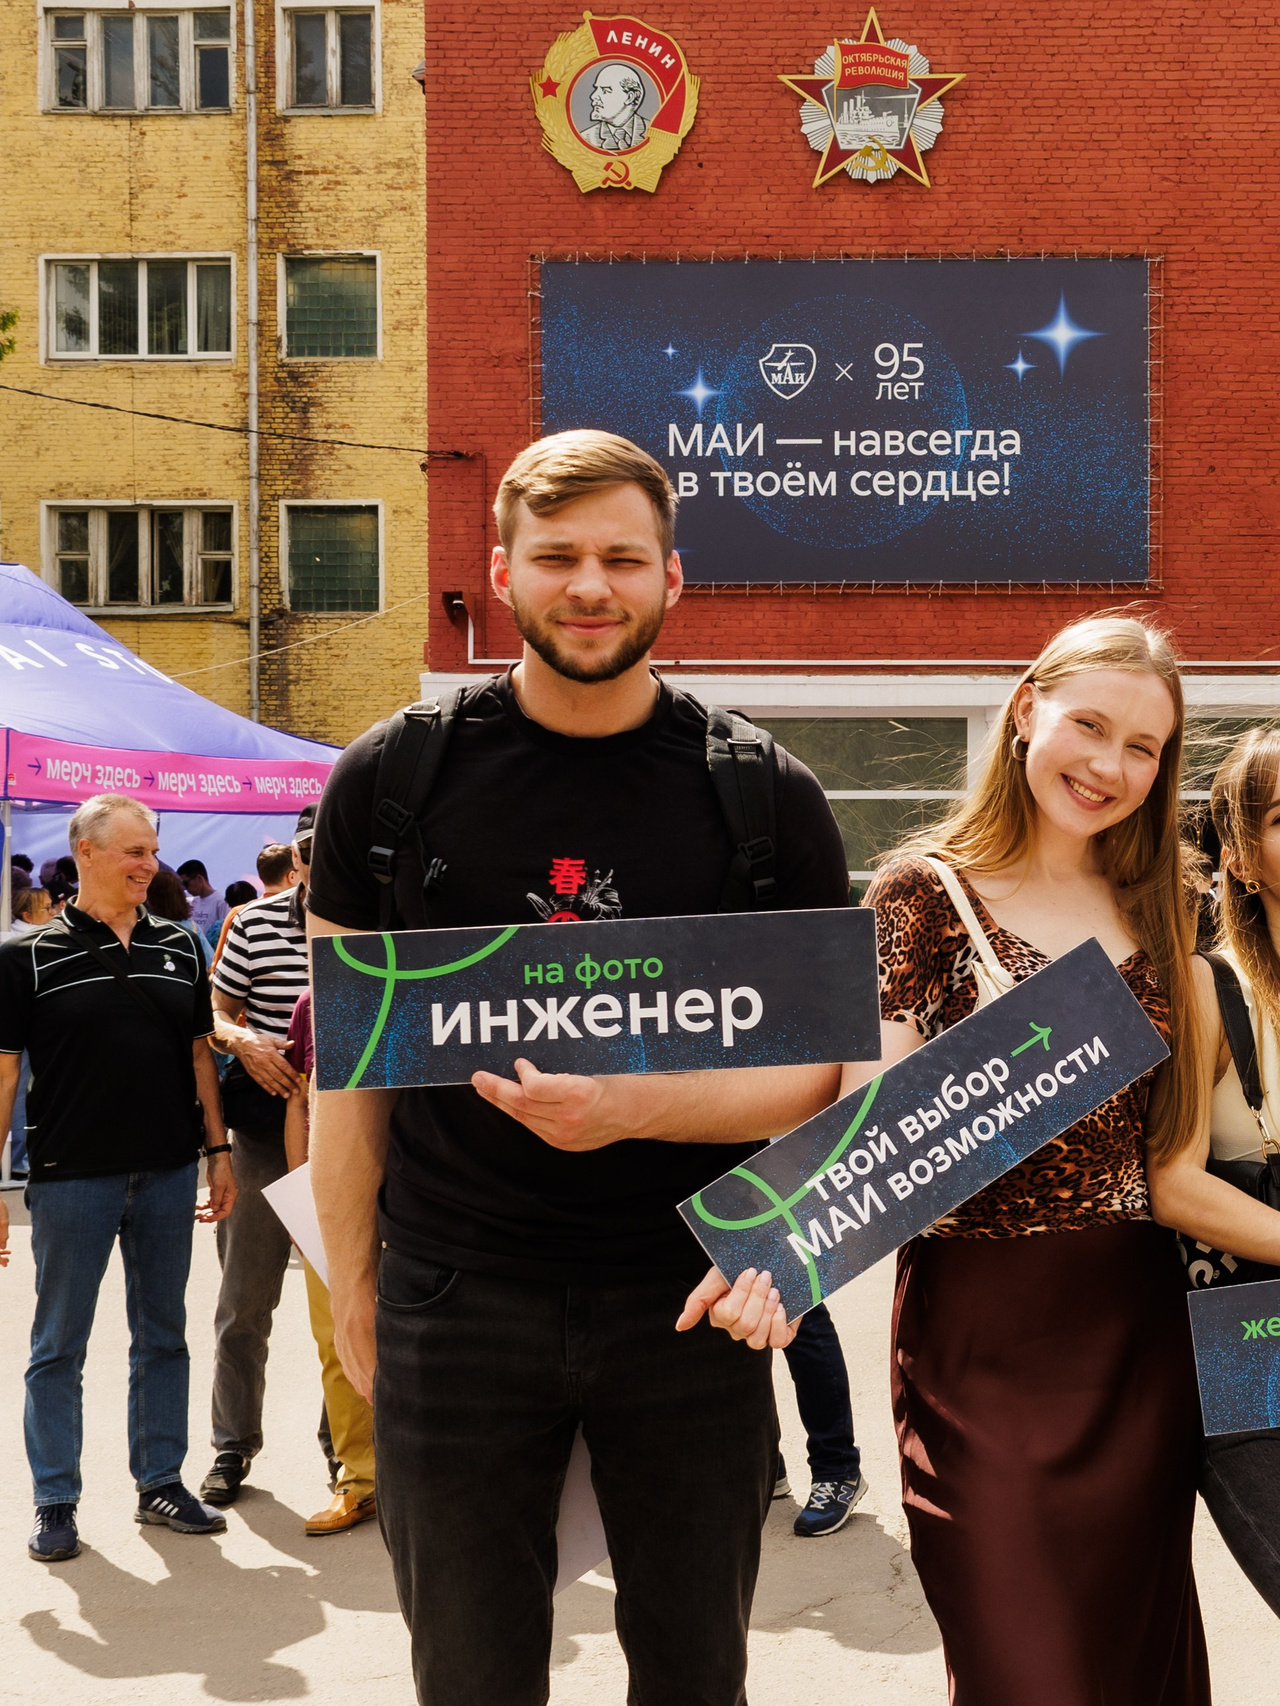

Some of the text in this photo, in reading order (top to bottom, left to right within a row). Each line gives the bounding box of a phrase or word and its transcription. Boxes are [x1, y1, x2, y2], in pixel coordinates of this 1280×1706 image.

[606, 30, 675, 69] ЛЕНИН
[842, 53, 908, 69] ОКТЯБРЬСКАЯ
[845, 66, 905, 81] РЕВОЛЮЦИЯ
[874, 343, 925, 380] 95
[875, 382, 925, 400] лет
[668, 423, 764, 457] МАИ
[834, 430, 1021, 461] навсегда
[678, 462, 1010, 505] в твоём сердце!
[46, 758, 323, 800] мерч здесь мерч здесь мерч здесь
[549, 858, 587, 894] 春
[524, 953, 664, 989] на фото
[431, 986, 764, 1047] инженер
[804, 1057, 1010, 1201] твой выбор
[786, 1036, 1110, 1266] МАИ возможности
